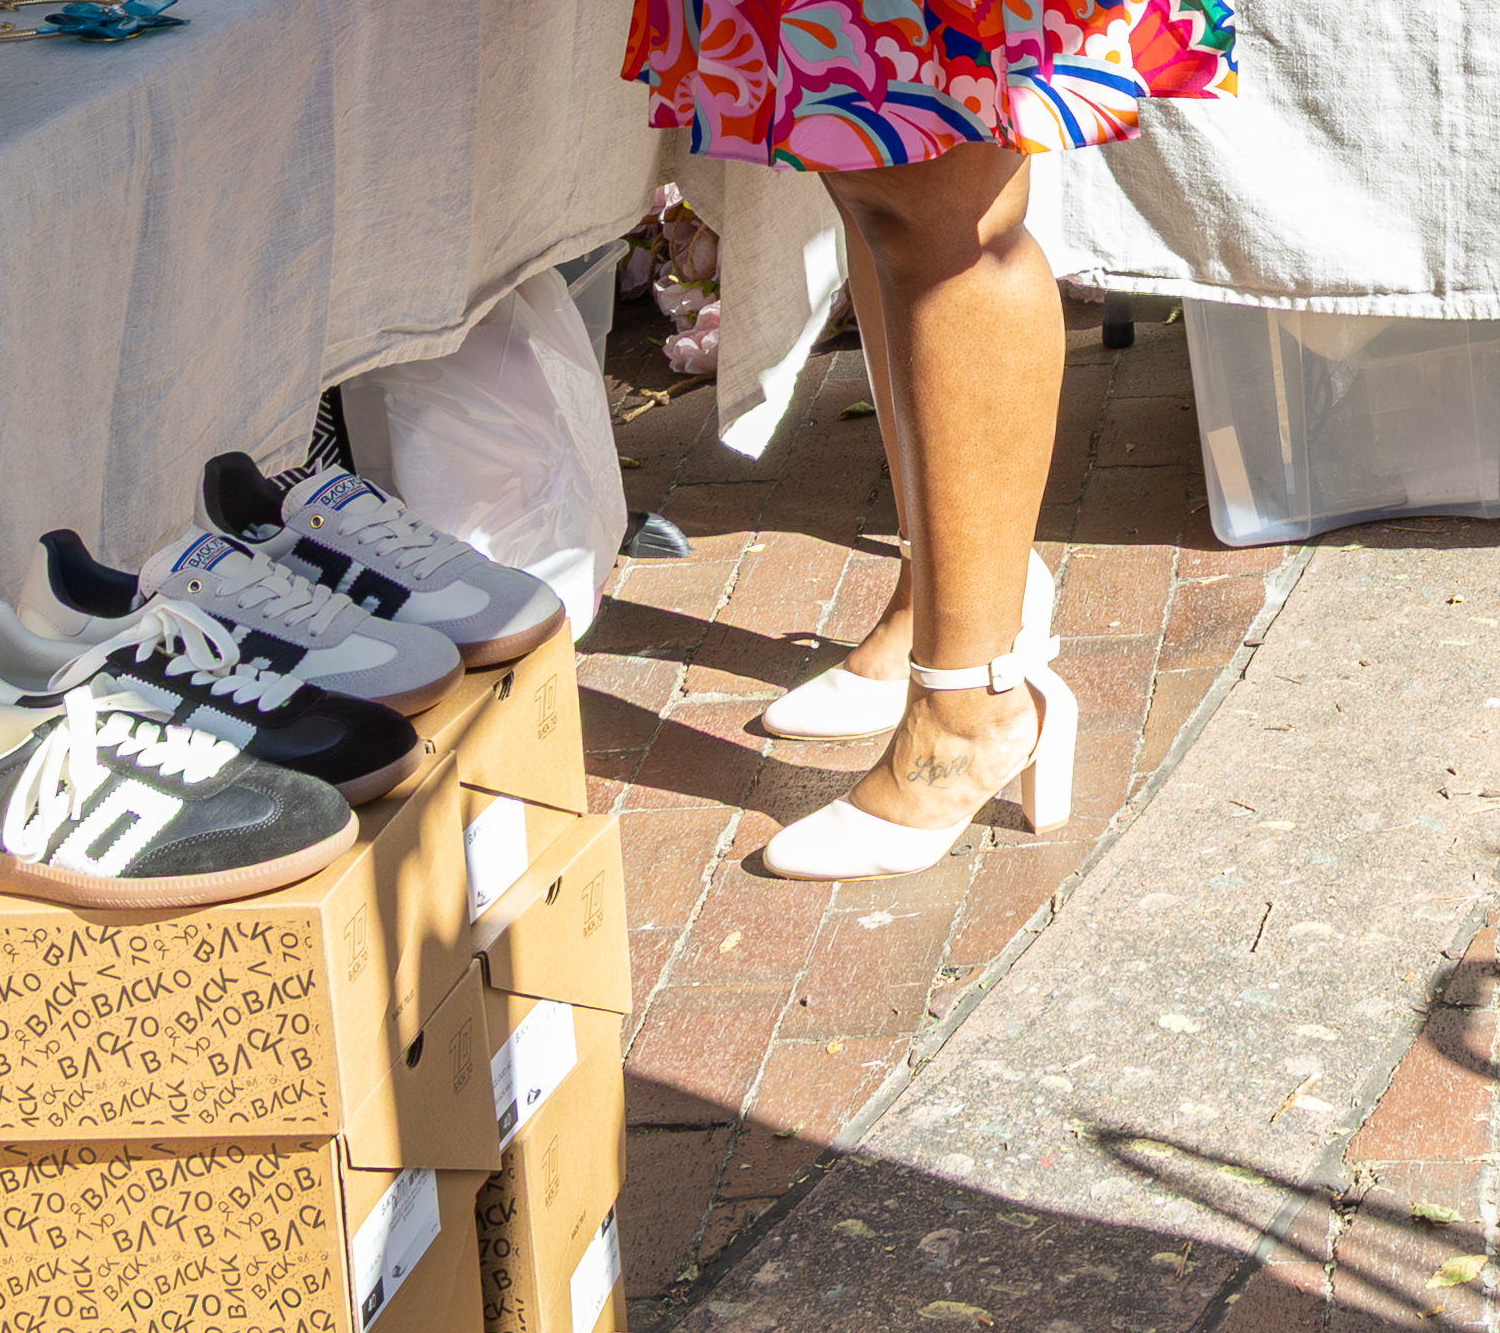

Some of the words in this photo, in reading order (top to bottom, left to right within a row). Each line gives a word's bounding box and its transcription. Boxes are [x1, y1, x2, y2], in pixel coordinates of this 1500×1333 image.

[320, 483, 347, 506] BACK
[189, 542, 213, 568] BACK
[25, 971, 89, 1037] BACK
[174, 967, 238, 1034] BACK
[276, 1014, 308, 1034] 70
[49, 1083, 94, 1127] BACK
[249, 1078, 310, 1118] BACK
[82, 1145, 144, 1211] BACK
[146, 1147, 226, 1192] BACK
[229, 1143, 291, 1209] BACK
[31, 1193, 65, 1213] 70
[8, 1258, 68, 1296] BACK
[154, 1257, 214, 1295] BACK
